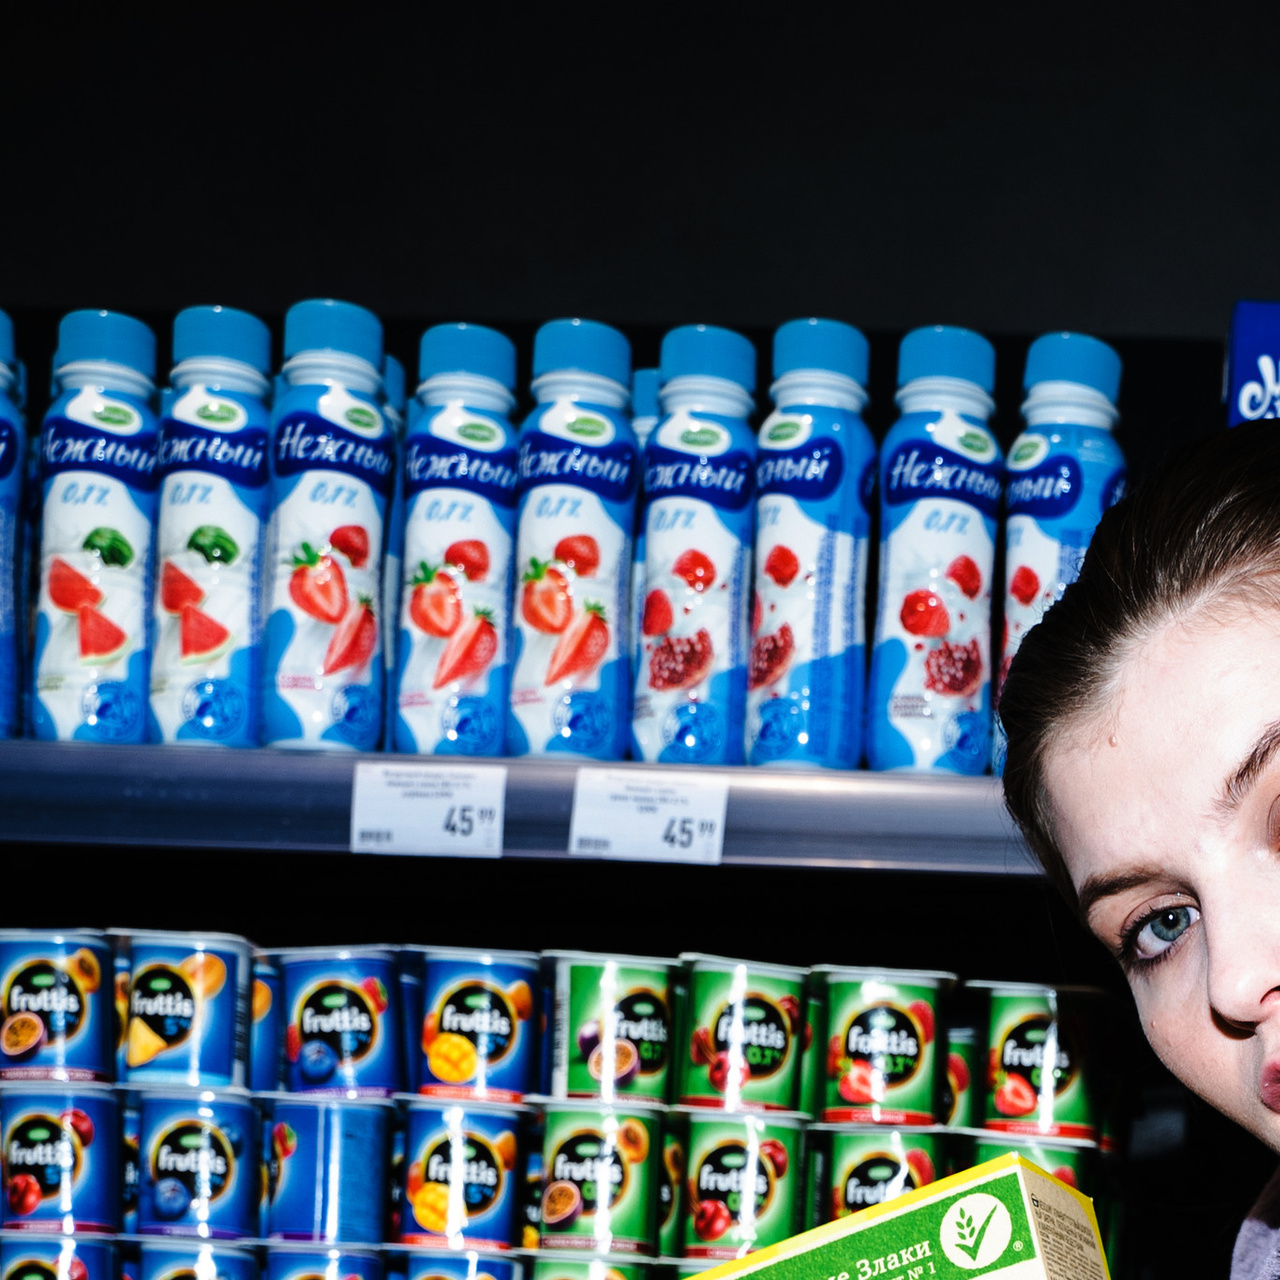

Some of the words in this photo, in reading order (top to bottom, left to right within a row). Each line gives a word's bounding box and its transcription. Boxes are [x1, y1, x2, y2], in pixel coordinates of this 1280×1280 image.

[443, 805, 475, 838] 45
[662, 817, 695, 850] 45
[10, 984, 80, 1014] fruttis
[131, 991, 195, 1018] fruttis
[302, 1007, 372, 1034] fruttis
[441, 1004, 511, 1034] fruttis
[848, 1025, 918, 1057] fruttis
[857, 1240, 933, 1280] Злаки
[927, 1261, 937, 1275] 1
